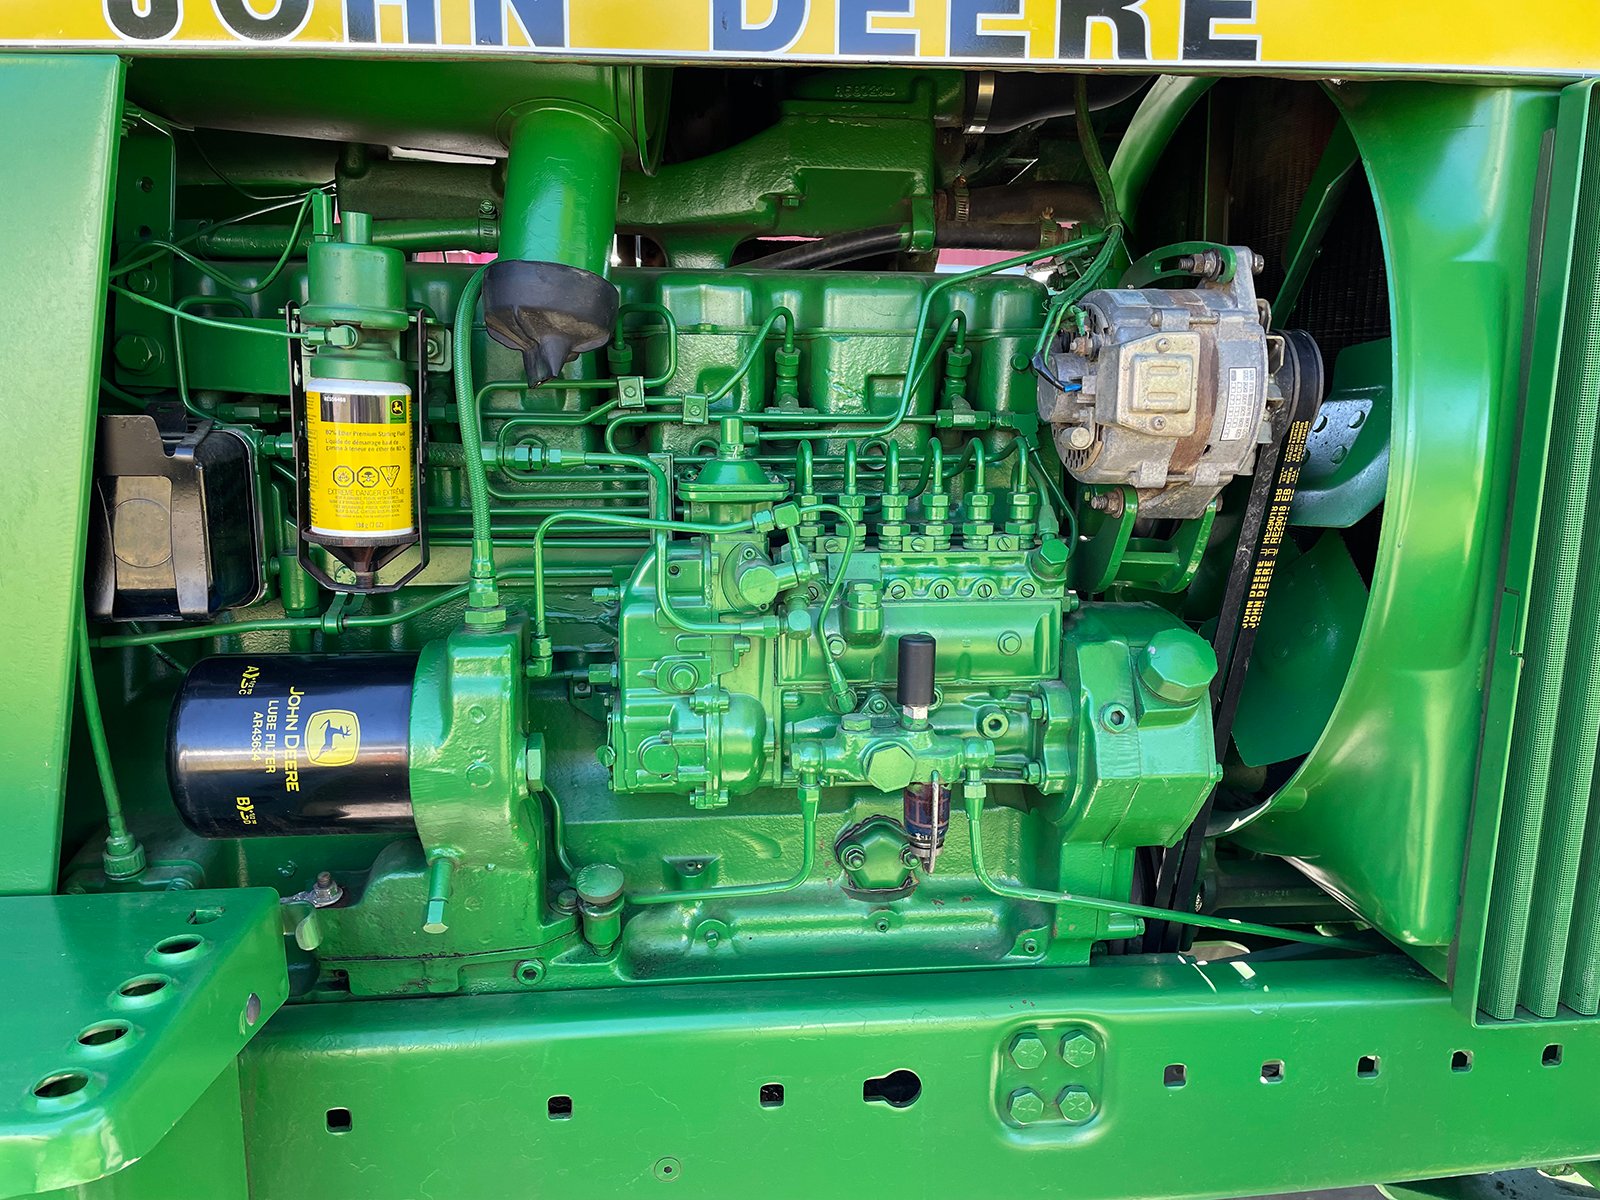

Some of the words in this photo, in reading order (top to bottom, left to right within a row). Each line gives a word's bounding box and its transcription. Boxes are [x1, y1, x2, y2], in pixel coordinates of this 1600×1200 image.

[1248, 600, 1262, 629] JOHN
[1256, 560, 1273, 597] DEERE
[1270, 505, 1287, 544] RE29018
[1281, 488, 1291, 501] EB
[246, 665, 259, 673] A
[266, 700, 279, 731] LUBE
[284, 686, 305, 731] JOHN
[251, 711, 263, 762] AR43634
[265, 733, 277, 774] FILTER
[284, 734, 300, 792] DEERE
[236, 796, 250, 806] B
